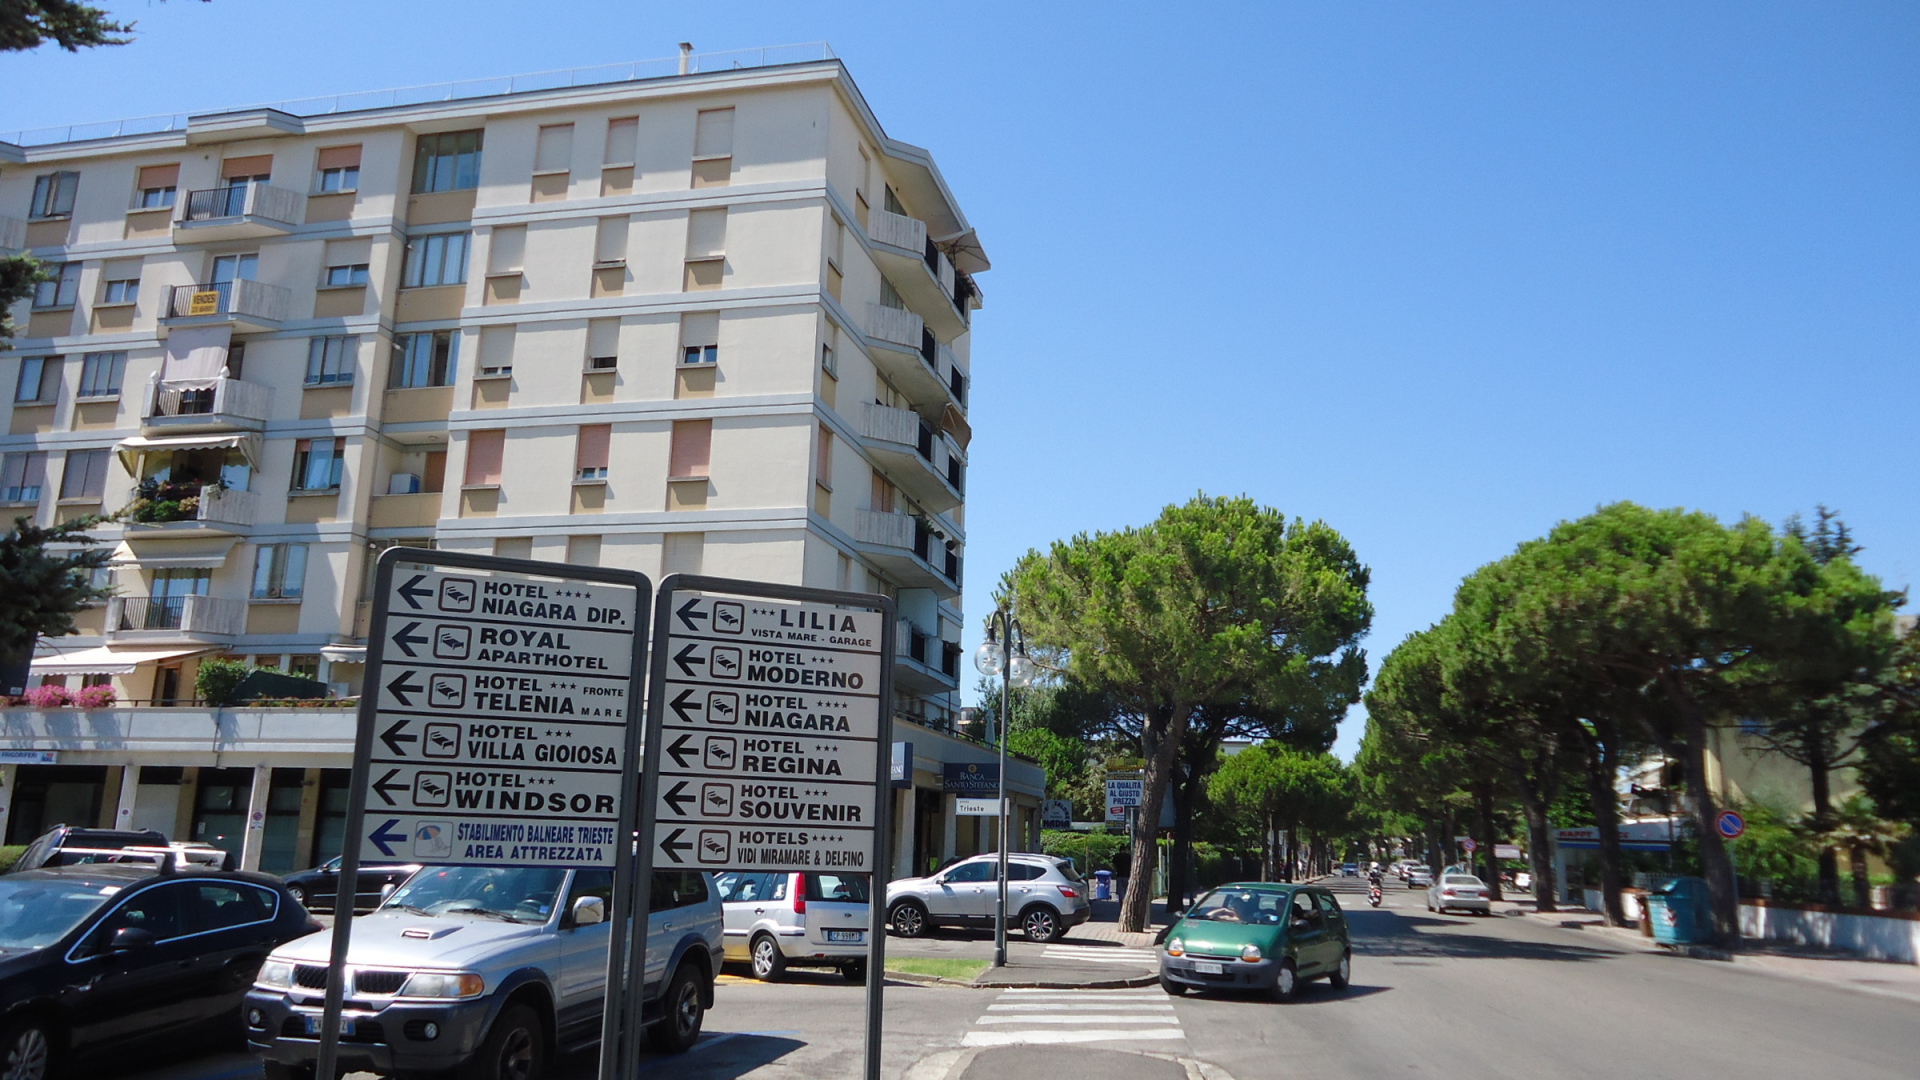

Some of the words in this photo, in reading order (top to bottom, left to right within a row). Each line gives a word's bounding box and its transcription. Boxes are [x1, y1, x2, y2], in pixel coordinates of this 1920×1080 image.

[484, 581, 548, 599] HOTEL
[482, 597, 577, 621] NIAGARA
[587, 607, 626, 625] DIP.
[780, 609, 856, 633] LILIA
[480, 627, 571, 650] ROYAL
[751, 628, 783, 639] VISTA
[787, 632, 817, 642] MARE
[829, 636, 872, 647] GARAGE
[477, 649, 608, 670] APARTHOTEL
[749, 649, 805, 665] HOTEL
[475, 675, 542, 692] HOTEL
[583, 686, 624, 697] FRONTE
[747, 665, 863, 690] MODERNO
[474, 692, 575, 715] TELENIA
[746, 694, 808, 710] HOTEL
[744, 709, 850, 732] NIAGARA
[469, 724, 538, 740] HOTEL
[468, 741, 525, 761] VILLA
[535, 744, 617, 765] GIOIOSA
[743, 739, 804, 754] HOTEL
[742, 755, 842, 776] REGINA
[960, 772, 985, 780] BANCA
[456, 771, 525, 788] HOTEL
[455, 789, 614, 814] WINDSOR
[741, 784, 799, 799] HOTEL
[739, 800, 861, 822] SOUVENIR
[457, 823, 524, 843] STABILIMENTO
[527, 825, 574, 844] BALNEARE
[578, 827, 614, 845] TRIESTE
[739, 831, 808, 845] HOTELS
[465, 844, 504, 859] AREA
[510, 846, 603, 861] ATTREZZATA
[737, 848, 756, 864] VIDI
[760, 849, 810, 865] MIRAMARE
[814, 850, 821, 866] &
[825, 850, 864, 867] DELFINO
